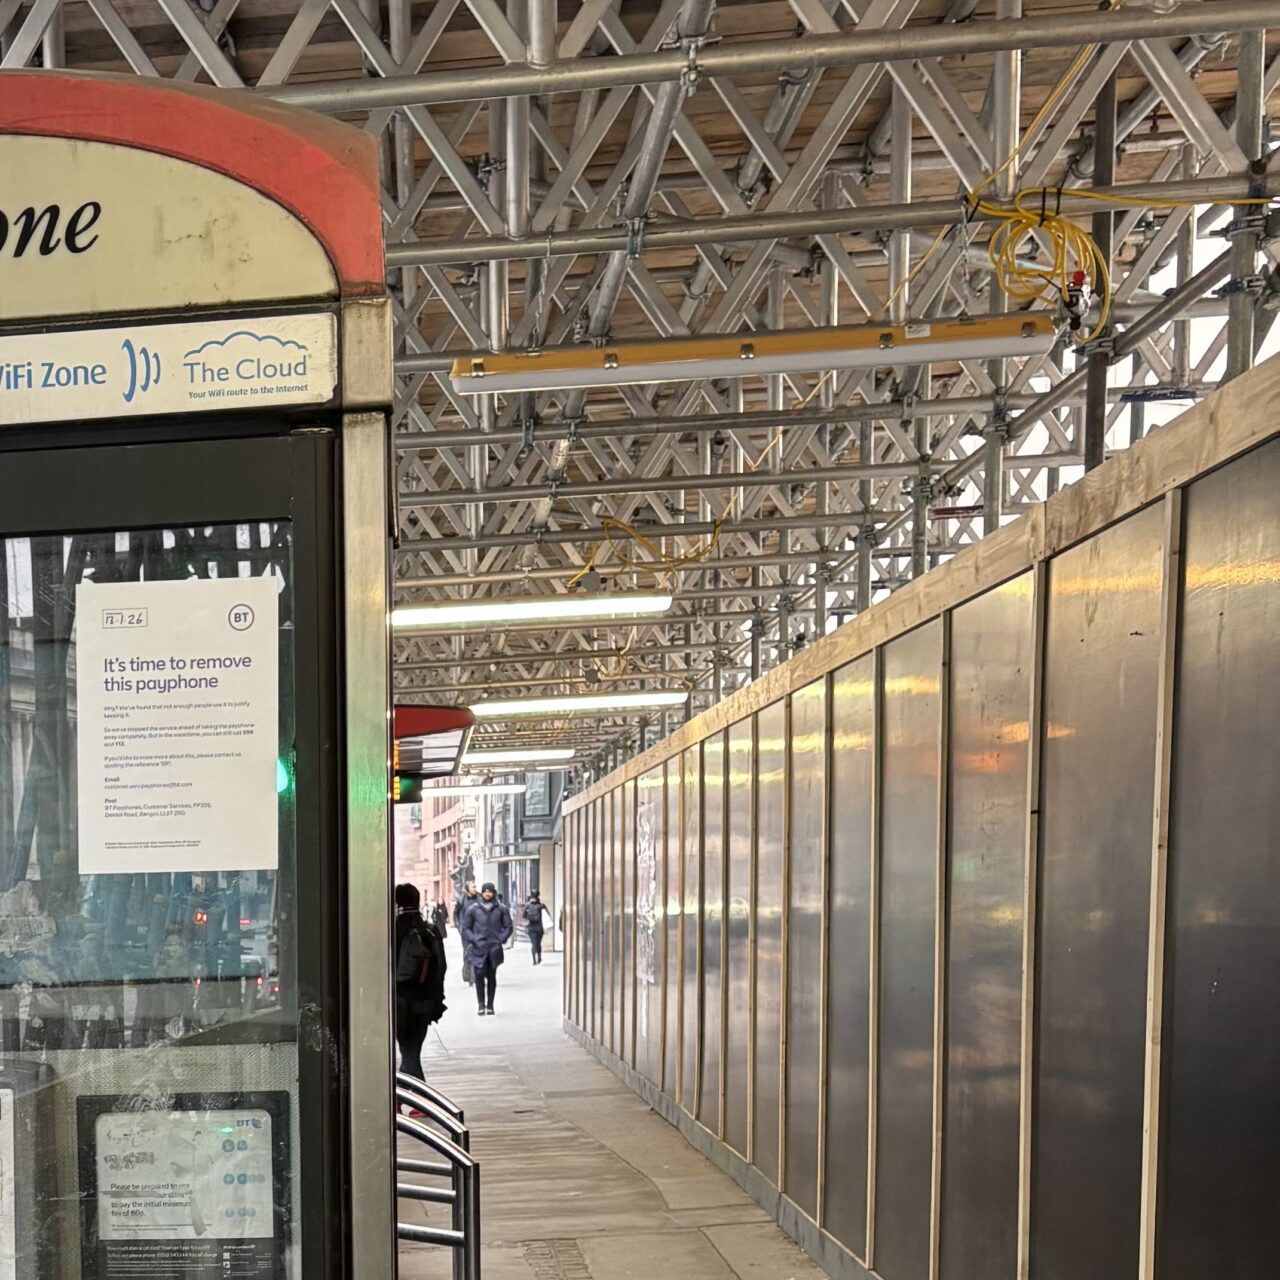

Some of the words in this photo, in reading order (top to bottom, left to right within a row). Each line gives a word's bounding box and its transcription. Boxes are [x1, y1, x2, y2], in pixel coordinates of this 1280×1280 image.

[40, 363, 107, 388] Zone
[183, 361, 230, 383] The
[235, 355, 307, 381] Cloud
[189, 390, 206, 399] Your
[208, 389, 225, 397] WiFi
[226, 388, 247, 396] route
[260, 386, 274, 394] the
[276, 384, 309, 393] Internet
[233, 612, 249, 623] BT
[130, 657, 166, 671] time
[169, 656, 186, 670] to
[190, 656, 251, 669] remove
[104, 677, 132, 691] this
[136, 674, 219, 694] payphone
